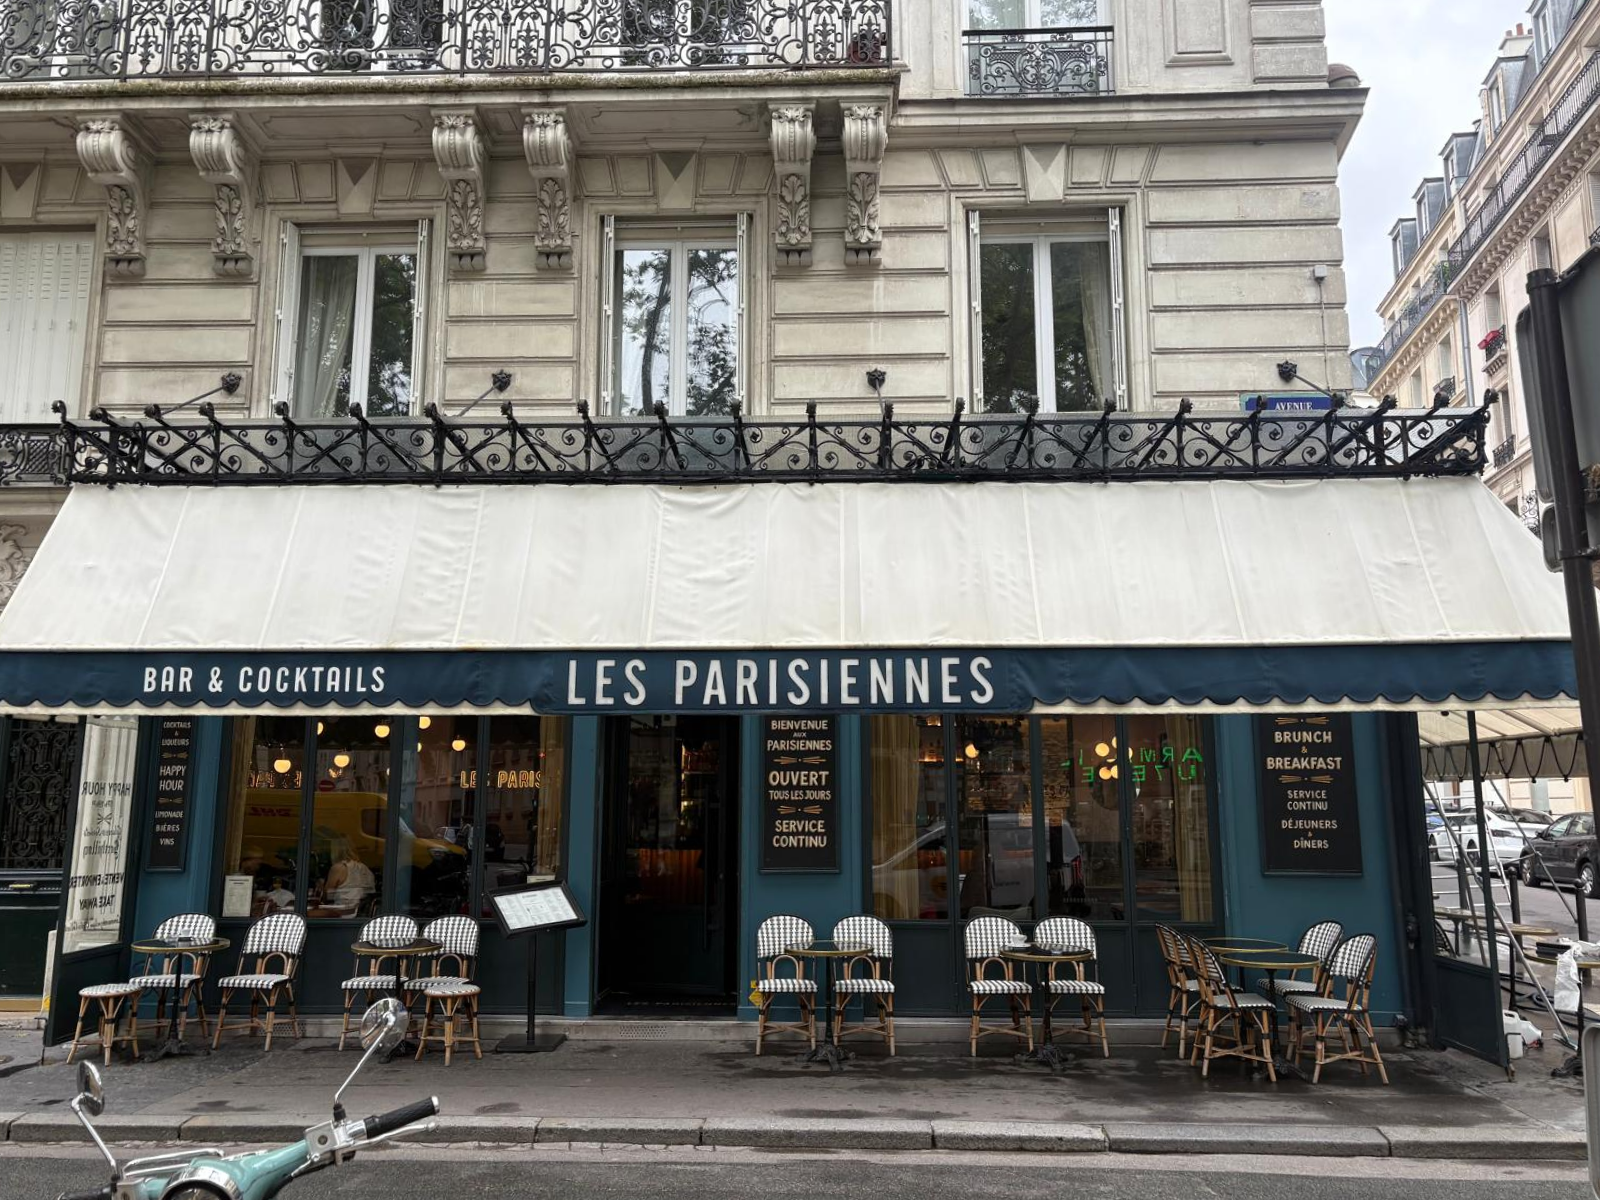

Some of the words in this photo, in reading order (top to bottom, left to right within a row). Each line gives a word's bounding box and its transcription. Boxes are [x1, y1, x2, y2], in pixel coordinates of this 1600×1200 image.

[1275, 402, 1313, 410] AVENUE
[143, 666, 193, 693] BAR
[208, 666, 223, 693] &
[238, 666, 385, 693] COCKTAILS
[567, 658, 647, 706] LES
[675, 656, 994, 706] PARISIENNES
[163, 721, 191, 729] COCKTAILS
[771, 720, 828, 730] BIENVENUE
[161, 738, 190, 746] LIQUEURS
[1274, 731, 1332, 743] BRUNCH
[767, 740, 832, 751] PARISIENNES
[1301, 745, 1308, 754] &
[1266, 757, 1342, 770] BREAKFAST
[159, 765, 187, 777] HAPPY
[768, 771, 829, 786] OUVERT
[159, 780, 184, 791] HOUR
[769, 790, 790, 800] TOUS
[791, 790, 803, 800] LES
[805, 790, 831, 800] JOURS
[1287, 790, 1327, 799] SERVICE
[1287, 801, 1328, 811] CONTINU
[156, 821, 180, 832] BIÈRES
[775, 820, 825, 833] SERVICE
[1281, 818, 1338, 829] DÉJEUNERS
[159, 837, 175, 846] VINS
[772, 835, 827, 848] CONTINU
[1294, 837, 1329, 849] DÎNERS
